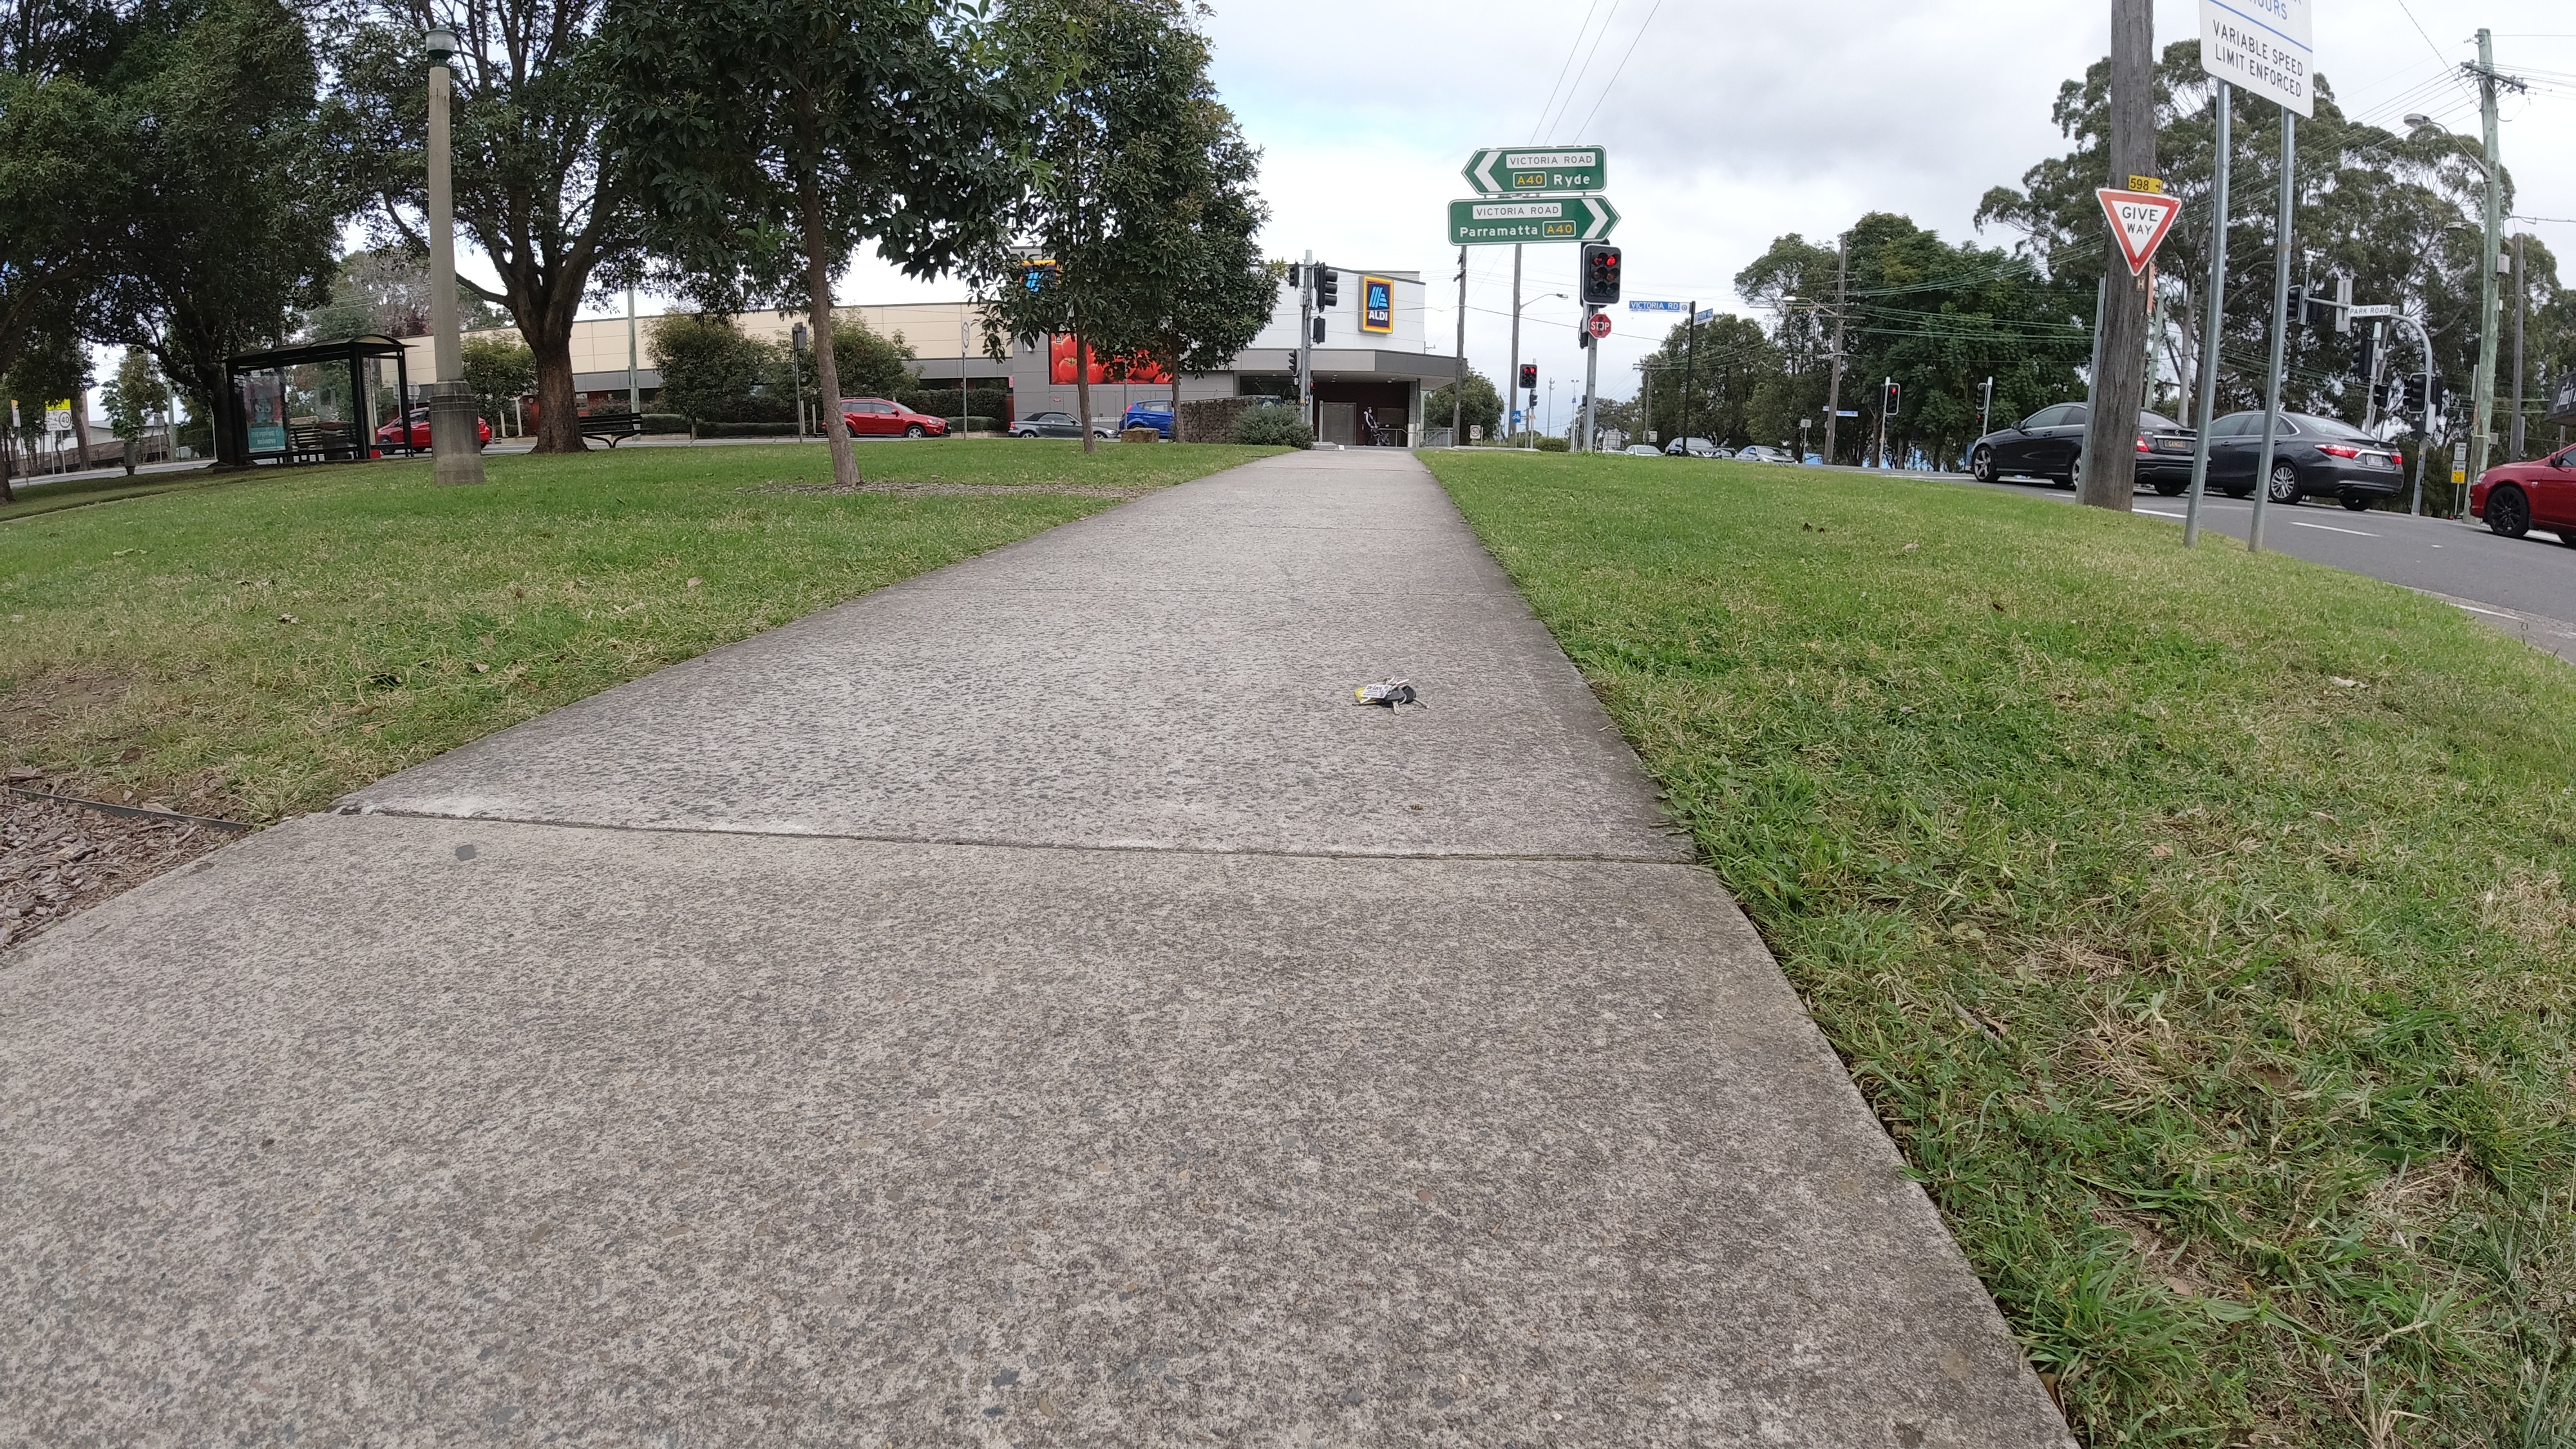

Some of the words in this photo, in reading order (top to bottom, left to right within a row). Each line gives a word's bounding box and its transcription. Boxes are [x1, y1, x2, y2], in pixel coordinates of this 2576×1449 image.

[2249, 0, 2287, 20] OURS
[2213, 19, 2268, 60] VARIABLE
[2272, 48, 2304, 77] SPEED
[2215, 43, 2245, 71] LIMIT
[2249, 59, 2302, 97] ENFORCED
[1510, 156, 1558, 165] VICTORIA
[1564, 155, 1593, 164] ROAD
[1517, 175, 1544, 185] A40
[1553, 173, 1591, 187] Ryde
[2130, 178, 2150, 191] 598
[1476, 207, 1525, 216] VICTORIA
[1530, 206, 1559, 214] ROAD
[2122, 206, 2158, 222] GIVE
[1459, 225, 1538, 238] Parramatta
[1546, 223, 1573, 234] A40
[2127, 222, 2152, 235] WAY
[1368, 310, 1388, 321] ALDI
[1591, 321, 1610, 331] STOP
